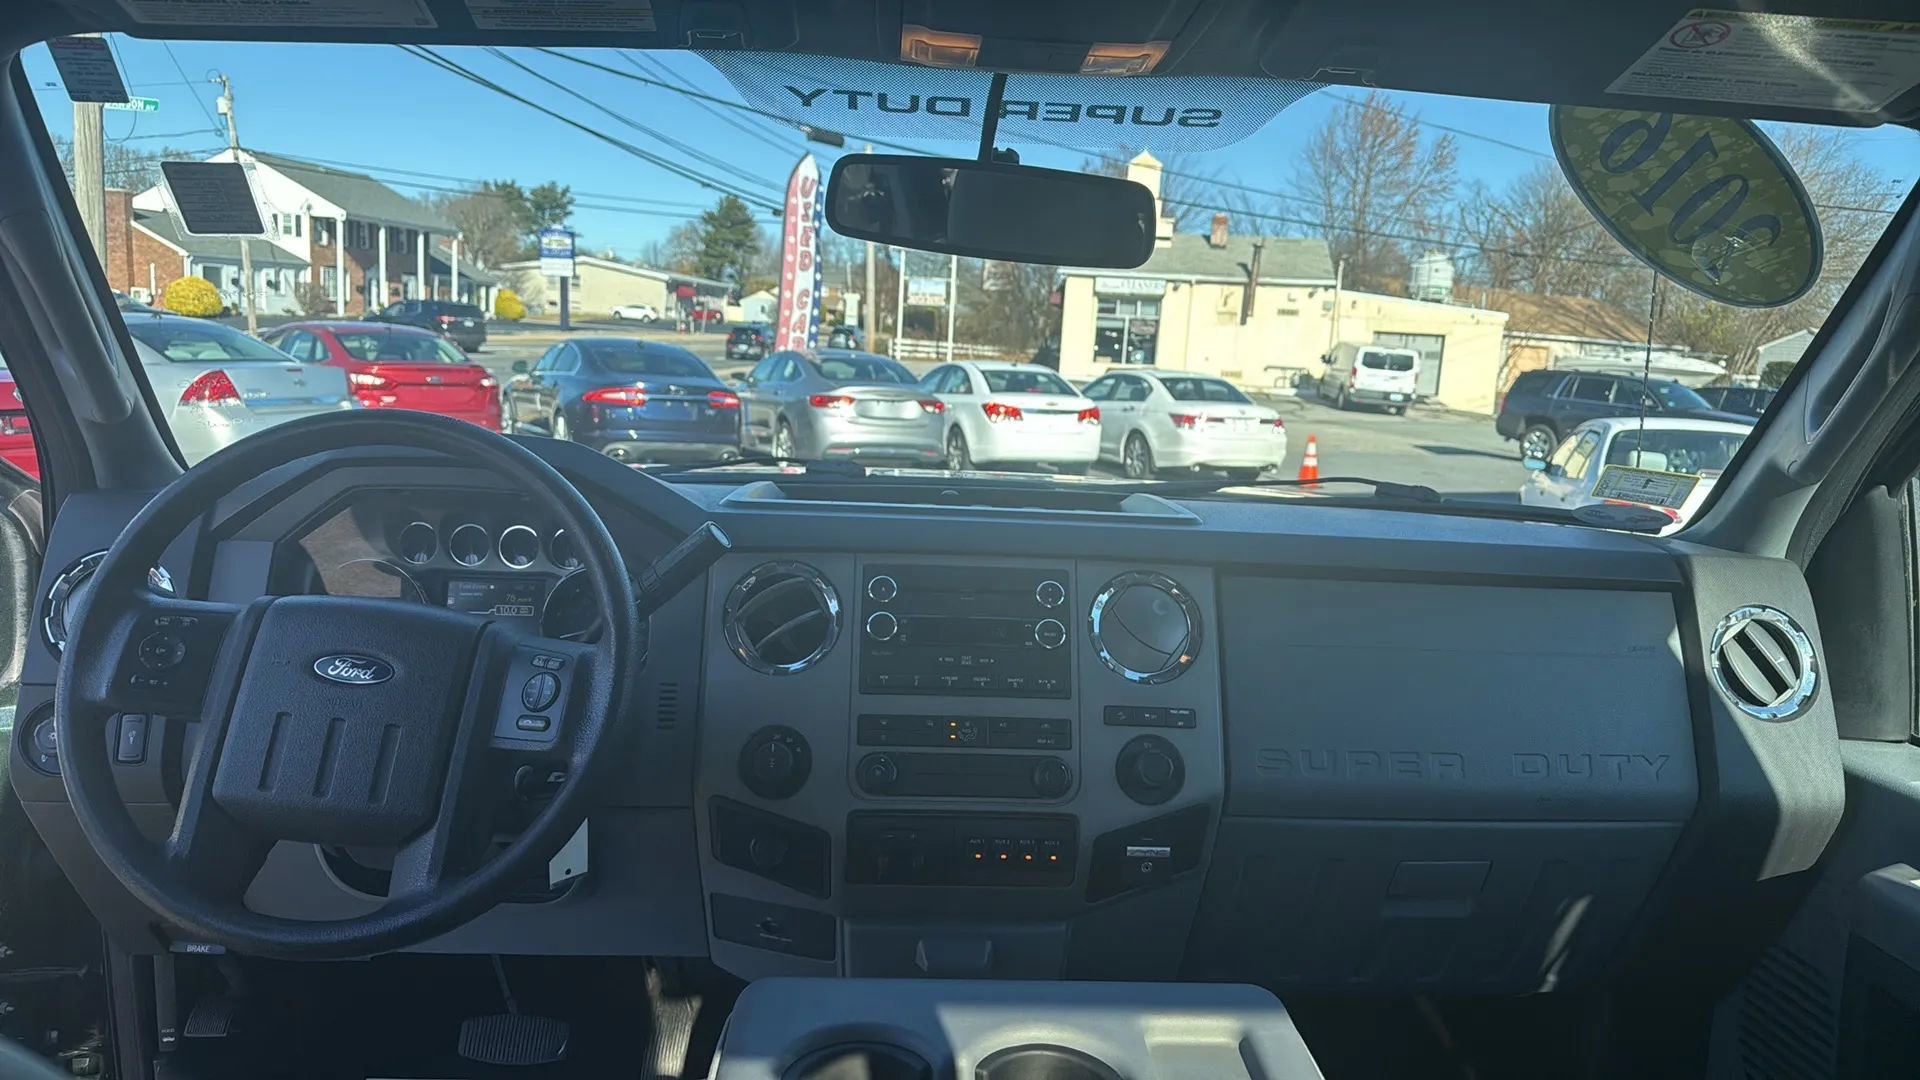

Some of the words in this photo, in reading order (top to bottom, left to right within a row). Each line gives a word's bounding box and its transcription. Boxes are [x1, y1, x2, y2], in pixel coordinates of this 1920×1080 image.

[799, 176, 816, 272] USED
[327, 657, 377, 680] Ford
[1255, 746, 1468, 782] SUPER
[1512, 750, 1671, 784] DUTY
[186, 944, 210, 953] BRAKE
